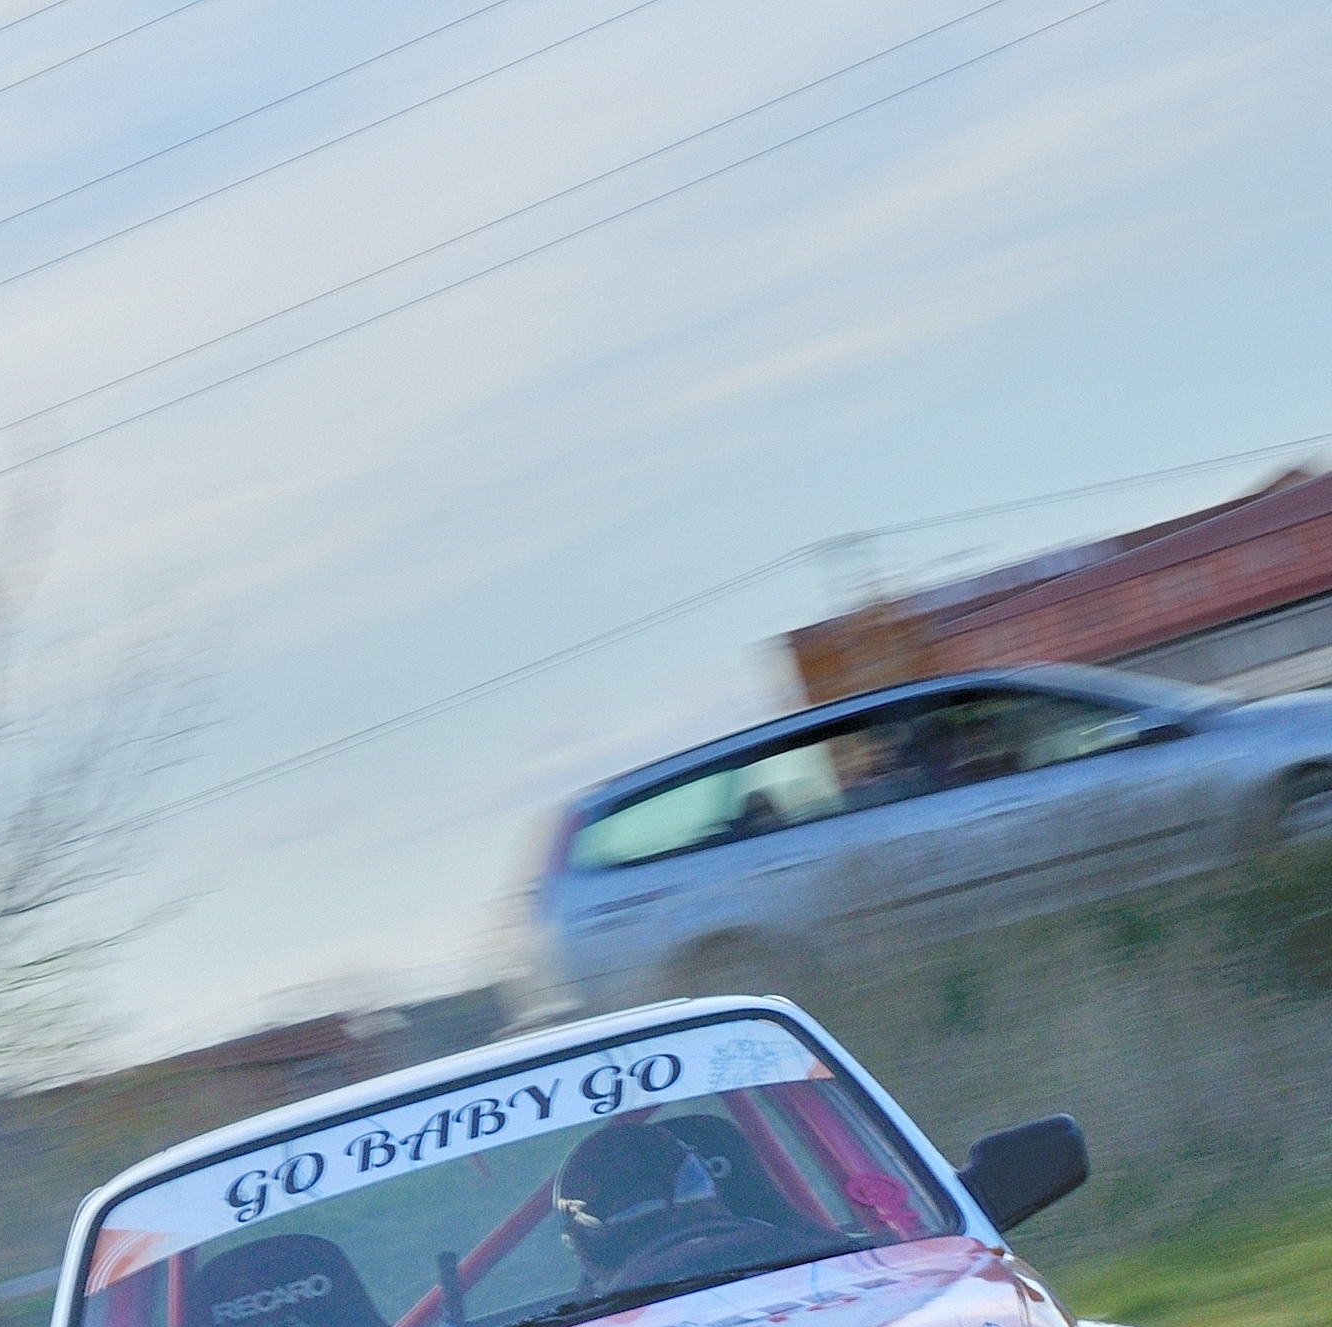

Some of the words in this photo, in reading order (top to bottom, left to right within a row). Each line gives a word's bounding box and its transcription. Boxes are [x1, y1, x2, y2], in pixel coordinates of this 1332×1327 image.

[225, 1152, 326, 1222] GO
[346, 1078, 562, 1171] BABY
[581, 1053, 682, 1114] GO
[212, 1272, 332, 1325] RECARO
